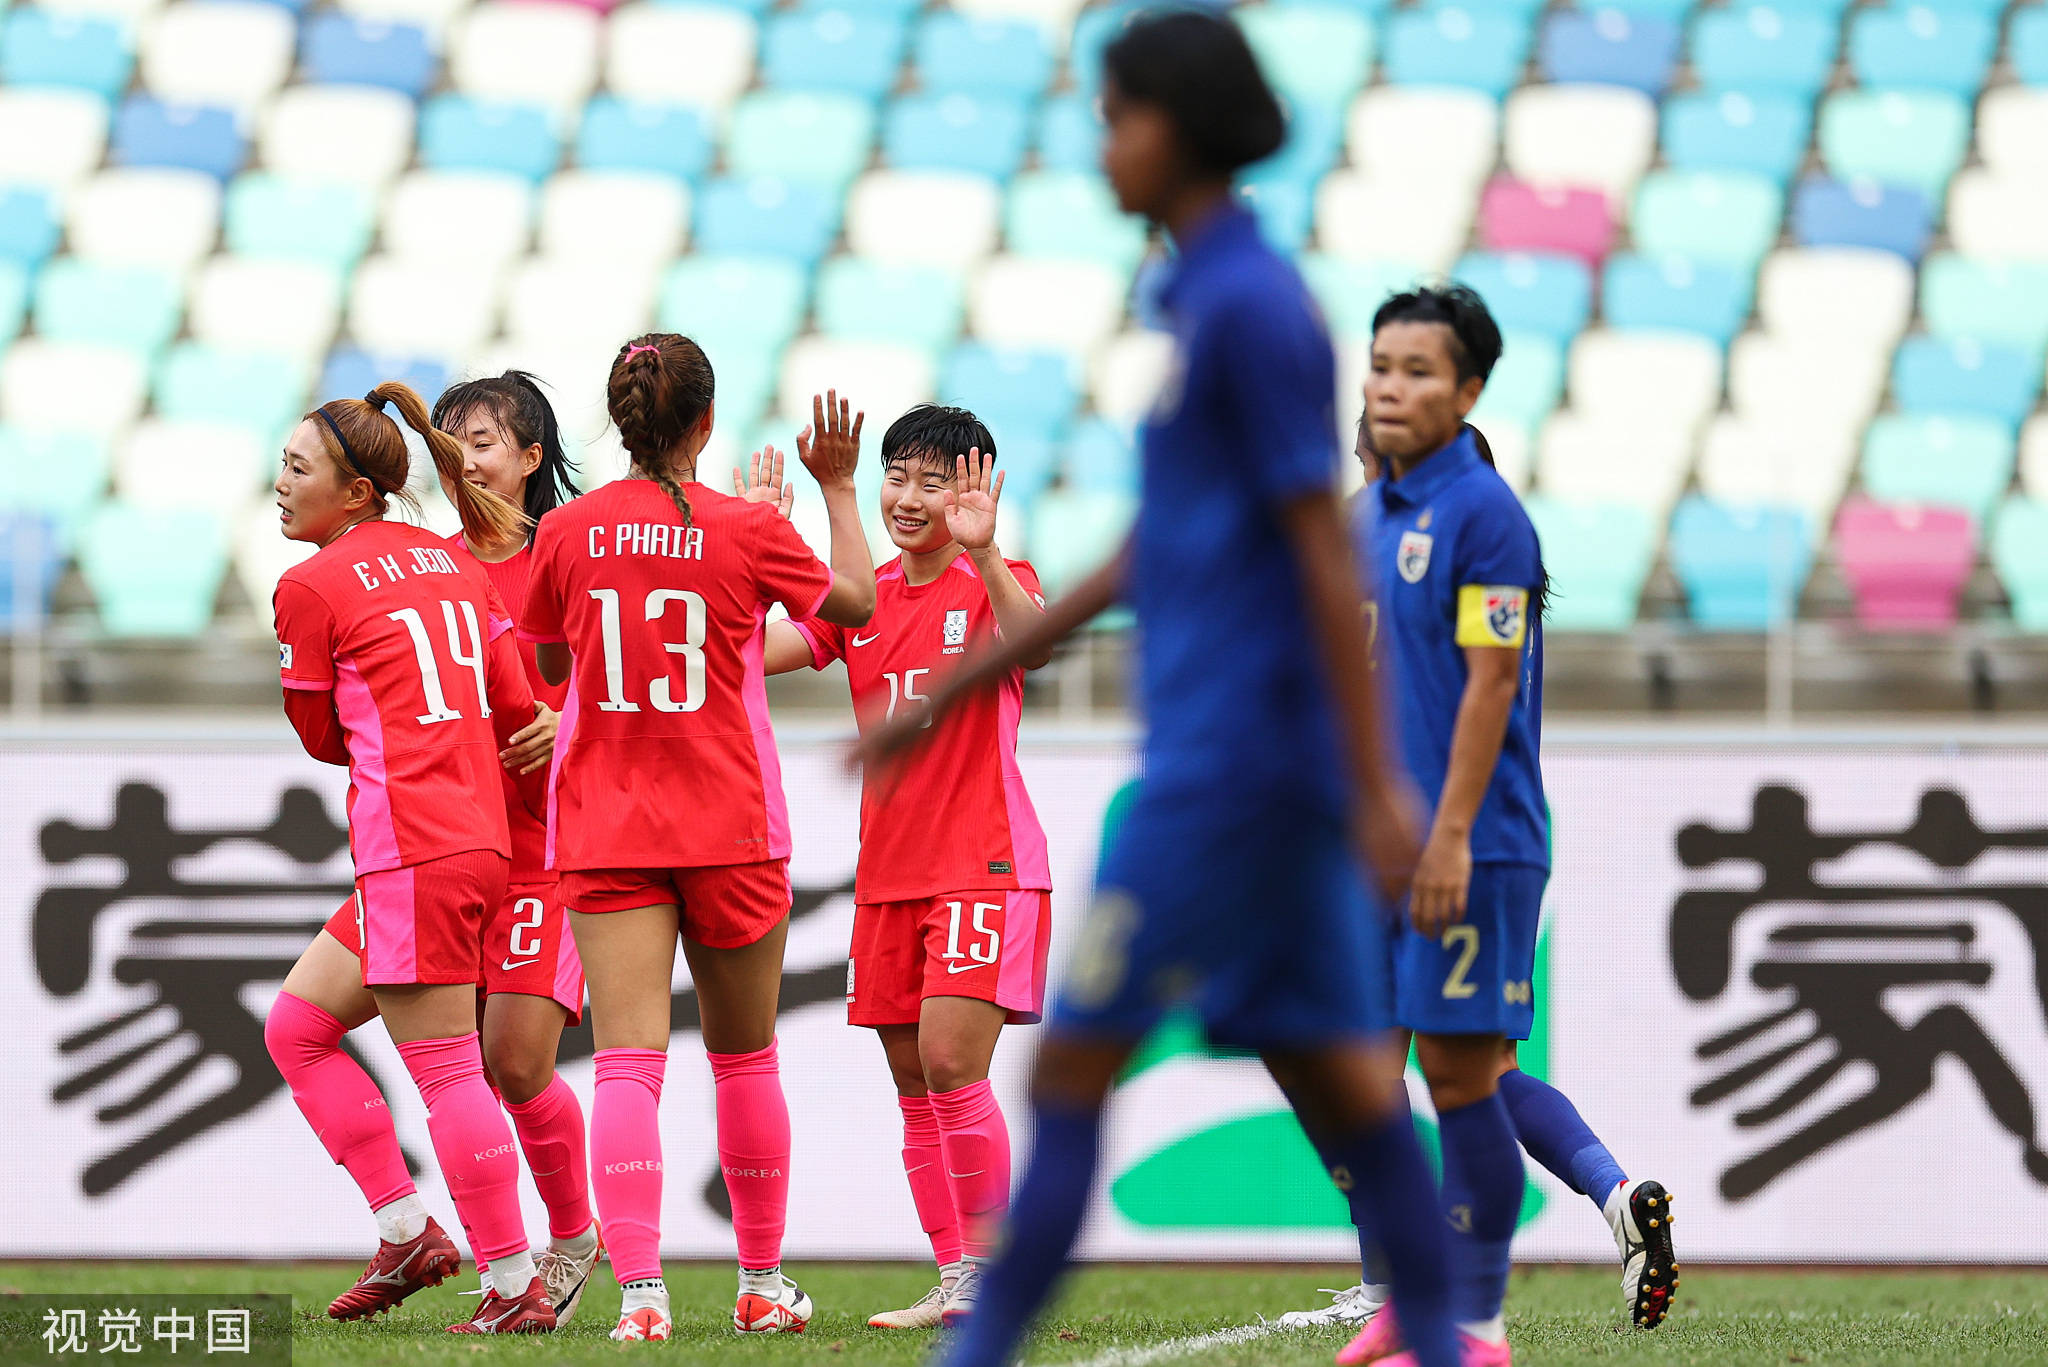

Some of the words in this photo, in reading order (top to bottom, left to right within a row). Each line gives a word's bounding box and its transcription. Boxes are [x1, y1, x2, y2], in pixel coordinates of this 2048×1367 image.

[352, 561, 380, 591] E
[377, 553, 406, 583] H
[407, 547, 460, 575] JEON
[588, 525, 605, 558] C
[615, 523, 704, 561] PHAIR
[386, 599, 493, 725] 14
[587, 588, 707, 713] 13
[942, 646, 965, 655] KOREA
[882, 668, 933, 729] 15
[509, 897, 545, 956] 2
[941, 901, 1003, 964] 15
[1441, 924, 1480, 999] 2
[605, 1160, 663, 1176] KOREA
[723, 1165, 782, 1178] KOREA
